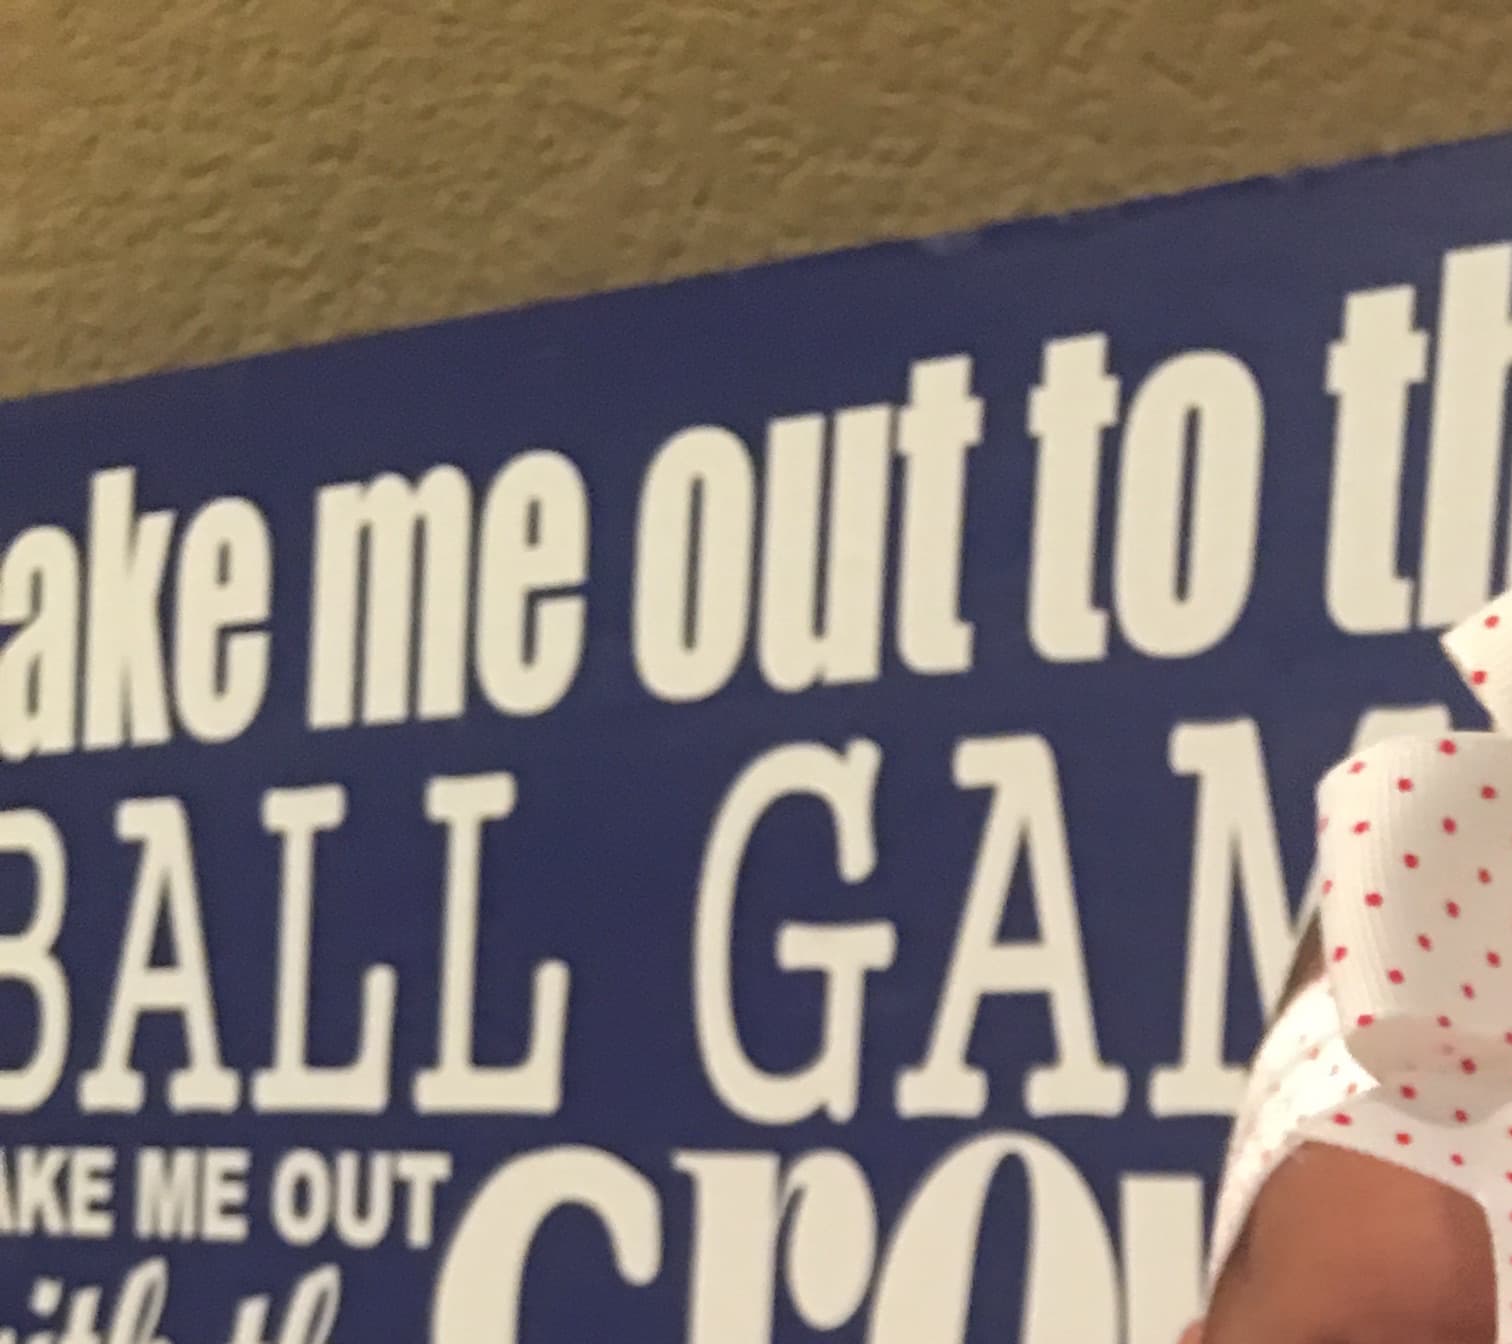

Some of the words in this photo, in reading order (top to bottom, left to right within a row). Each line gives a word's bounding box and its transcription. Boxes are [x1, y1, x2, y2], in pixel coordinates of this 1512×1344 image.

[307, 448, 589, 731] me
[632, 353, 984, 703] out
[1027, 333, 1264, 663] to
[0, 772, 570, 1114] BALL
[135, 1147, 252, 1242] ME
[271, 1149, 453, 1249] OUT
